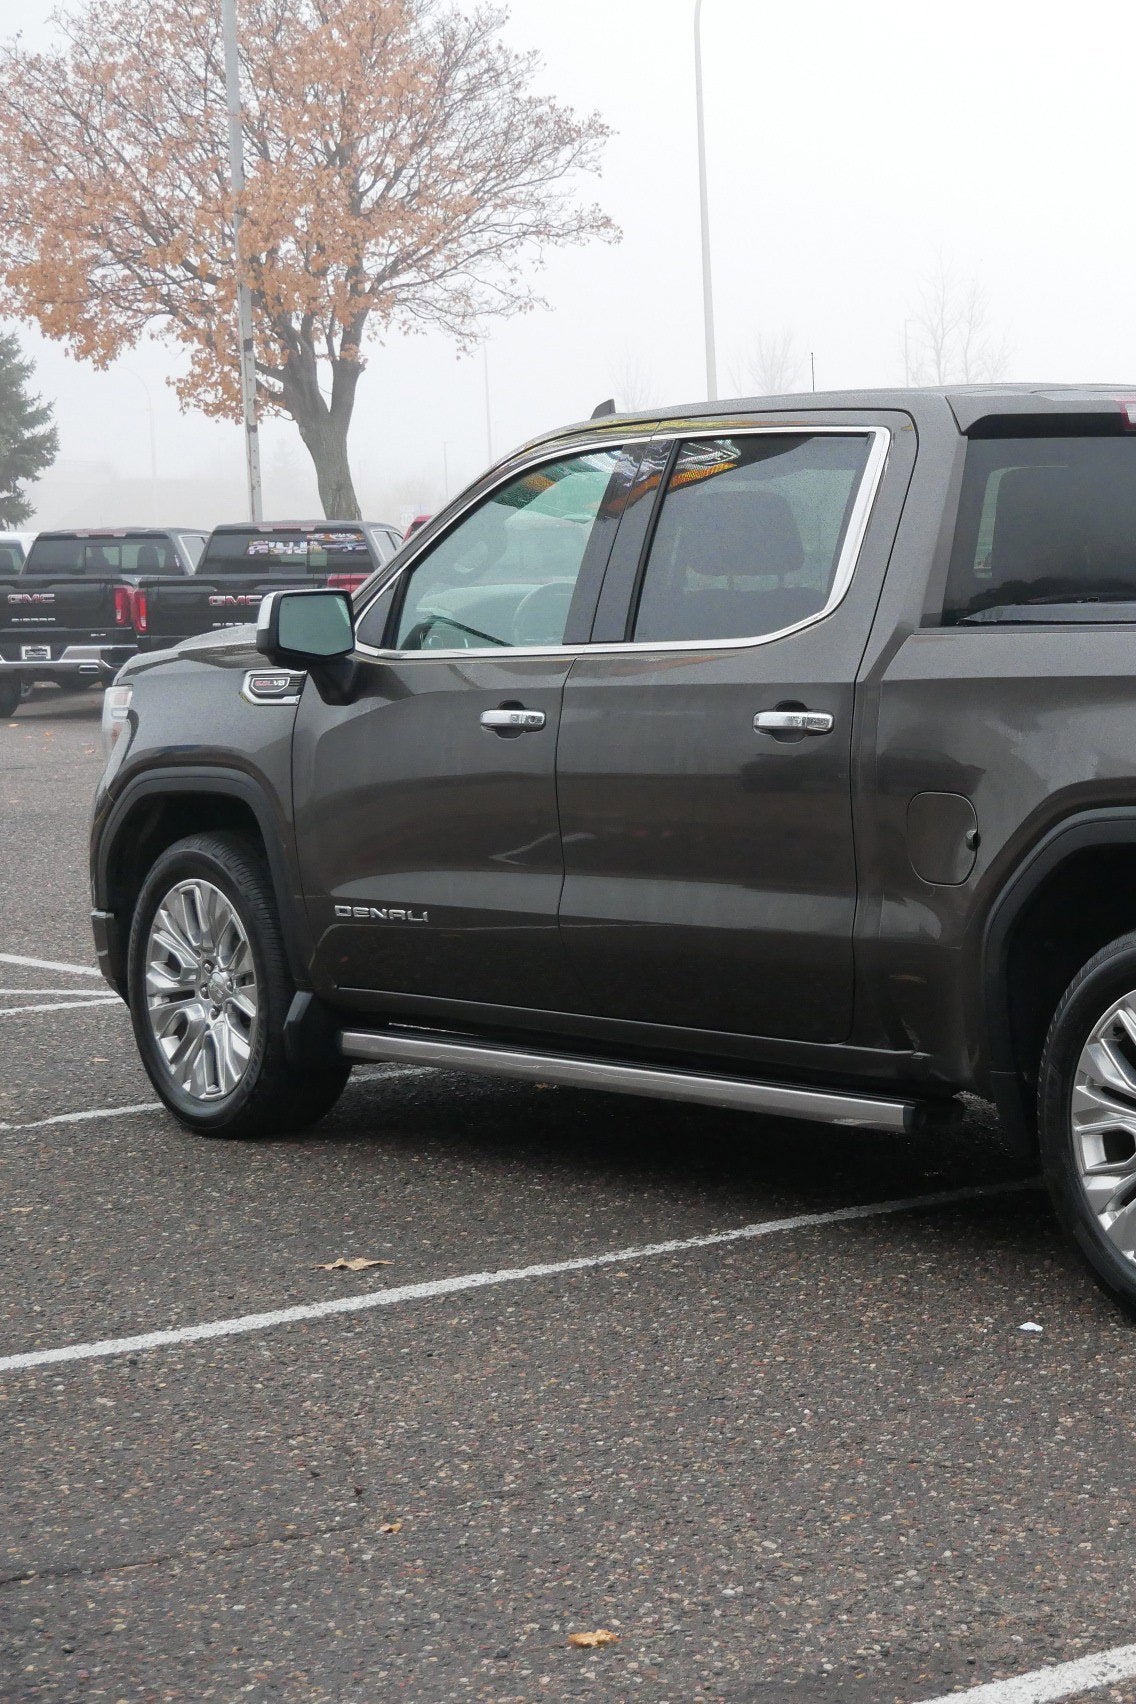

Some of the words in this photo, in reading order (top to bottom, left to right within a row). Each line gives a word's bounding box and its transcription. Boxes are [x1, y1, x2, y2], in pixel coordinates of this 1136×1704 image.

[8, 593, 55, 604] GMC
[209, 594, 263, 606] GMC
[334, 904, 429, 923] DENALI
